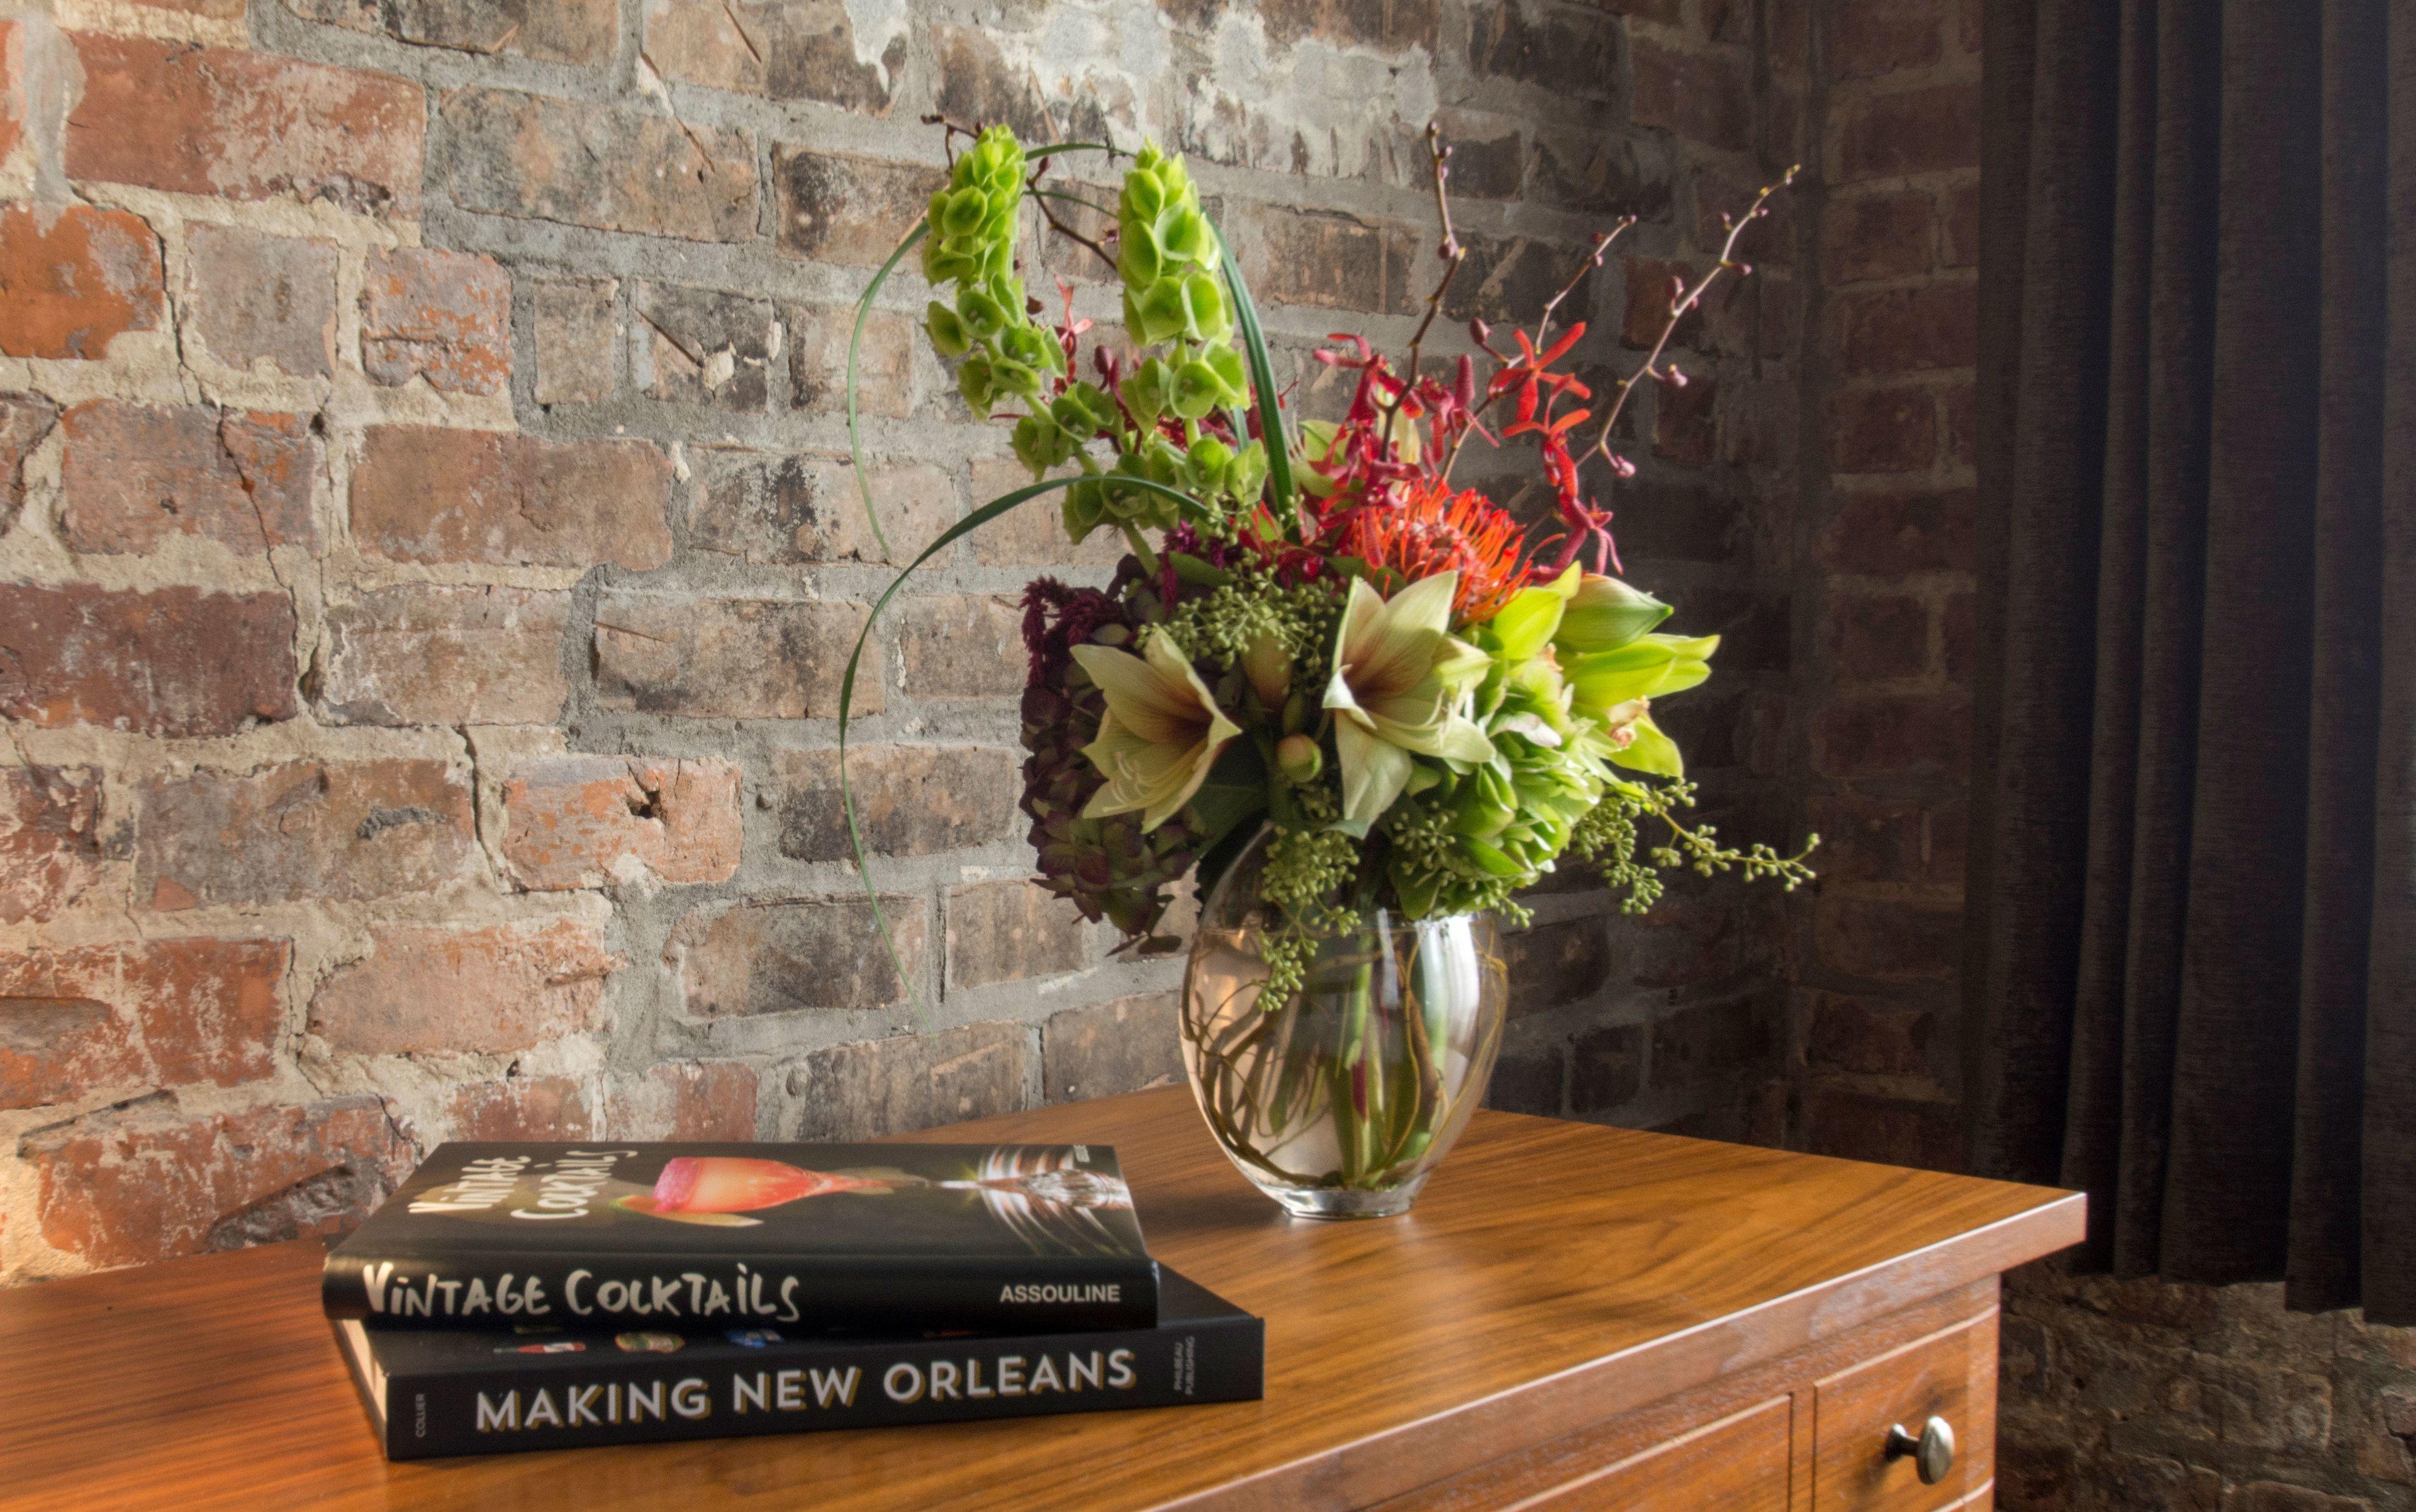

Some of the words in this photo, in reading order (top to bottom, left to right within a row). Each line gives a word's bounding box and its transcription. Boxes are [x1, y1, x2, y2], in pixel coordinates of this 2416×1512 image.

[999, 1284, 1121, 1304] ASSOULINE
[476, 1379, 712, 1432] MAKING
[732, 1365, 863, 1415] NEW
[883, 1348, 1136, 1405] ORLEANS
[415, 1392, 427, 1438] COLLIER
